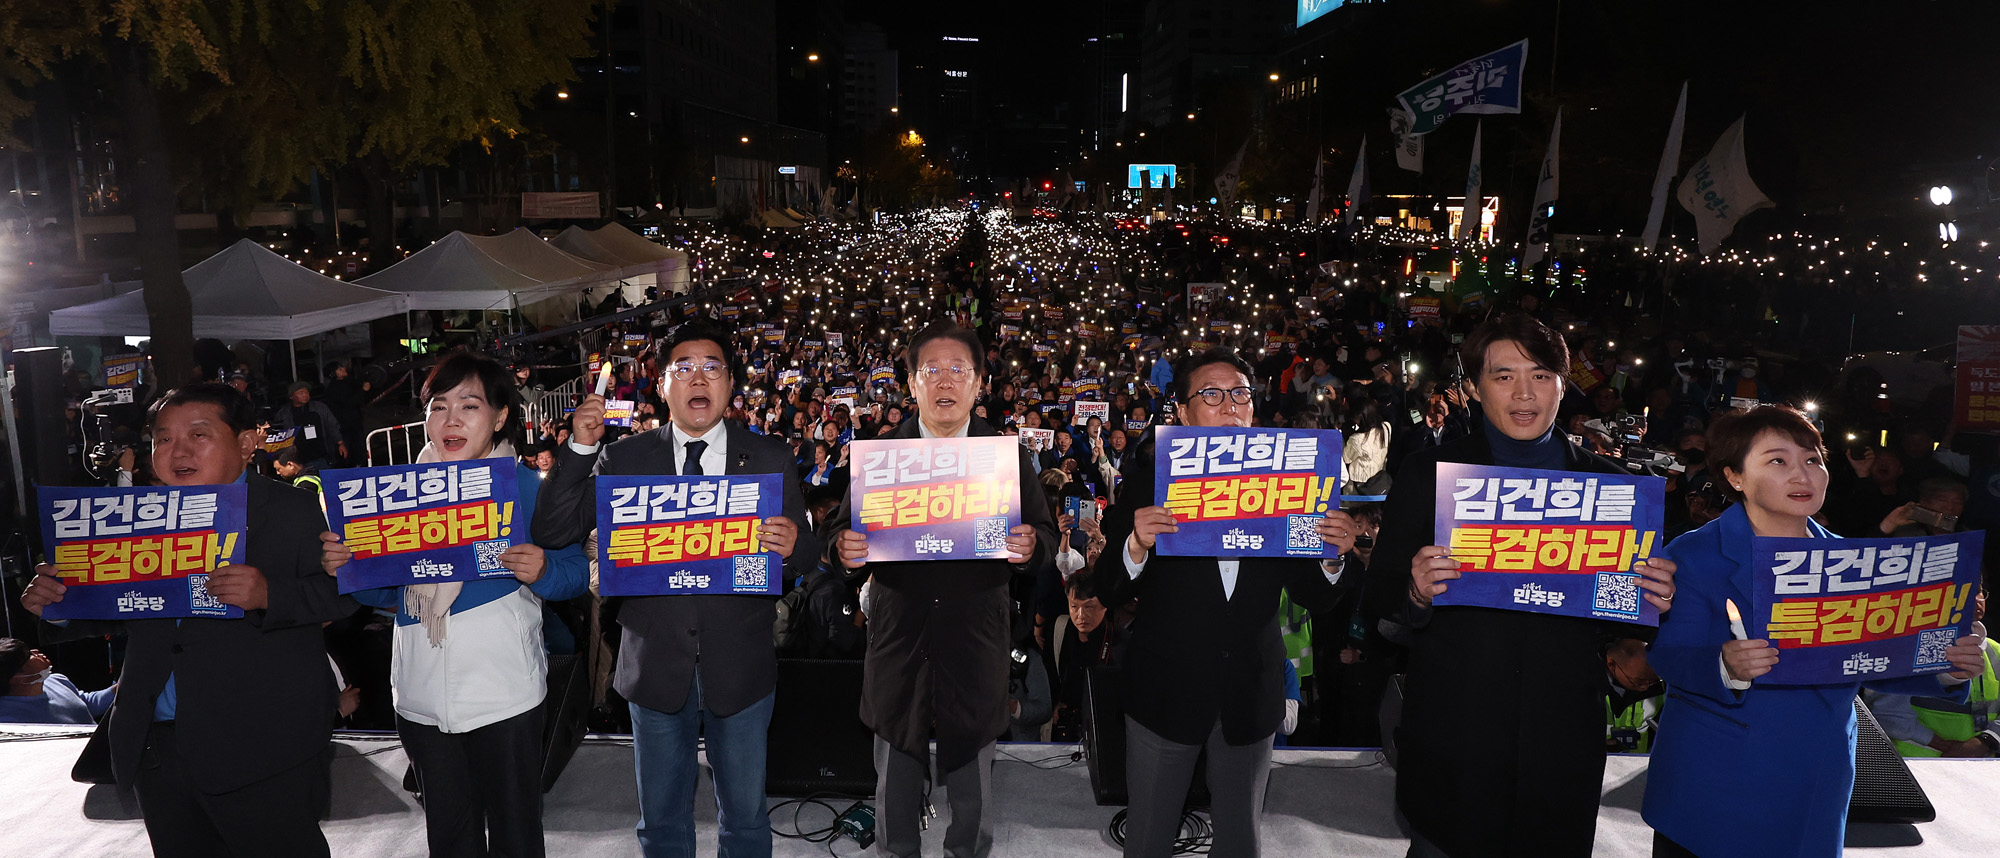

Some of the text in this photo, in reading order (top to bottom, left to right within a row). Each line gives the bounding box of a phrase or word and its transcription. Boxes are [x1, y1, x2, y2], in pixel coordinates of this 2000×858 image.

[862, 444, 997, 487] 김건희를
[1169, 432, 1319, 477] 김건희를
[338, 465, 493, 517] 김건희를
[610, 479, 760, 524] 김건희를
[859, 479, 1014, 527] 특검하라!
[1163, 476, 1336, 520] 특검하라!
[1452, 477, 1636, 522] 김건희를
[52, 490, 218, 539] 김건희를
[343, 501, 514, 555] 특검하라!
[55, 532, 239, 583] 특검하라!
[607, 518, 773, 564] 특검하라
[914, 538, 955, 554] 민주당
[1222, 533, 1264, 550] 민주당
[1447, 527, 1656, 572] 특검하라!
[411, 563, 454, 578] 민주당
[669, 574, 711, 589] 민주당
[1771, 541, 1959, 595] 김건희를
[117, 596, 165, 612] 민주당
[1513, 587, 1566, 608] 민주당
[1592, 610, 1639, 621] sign.theminjoo.kr
[1766, 582, 1972, 645] 특검하라!
[1842, 656, 1891, 676] 민주당
